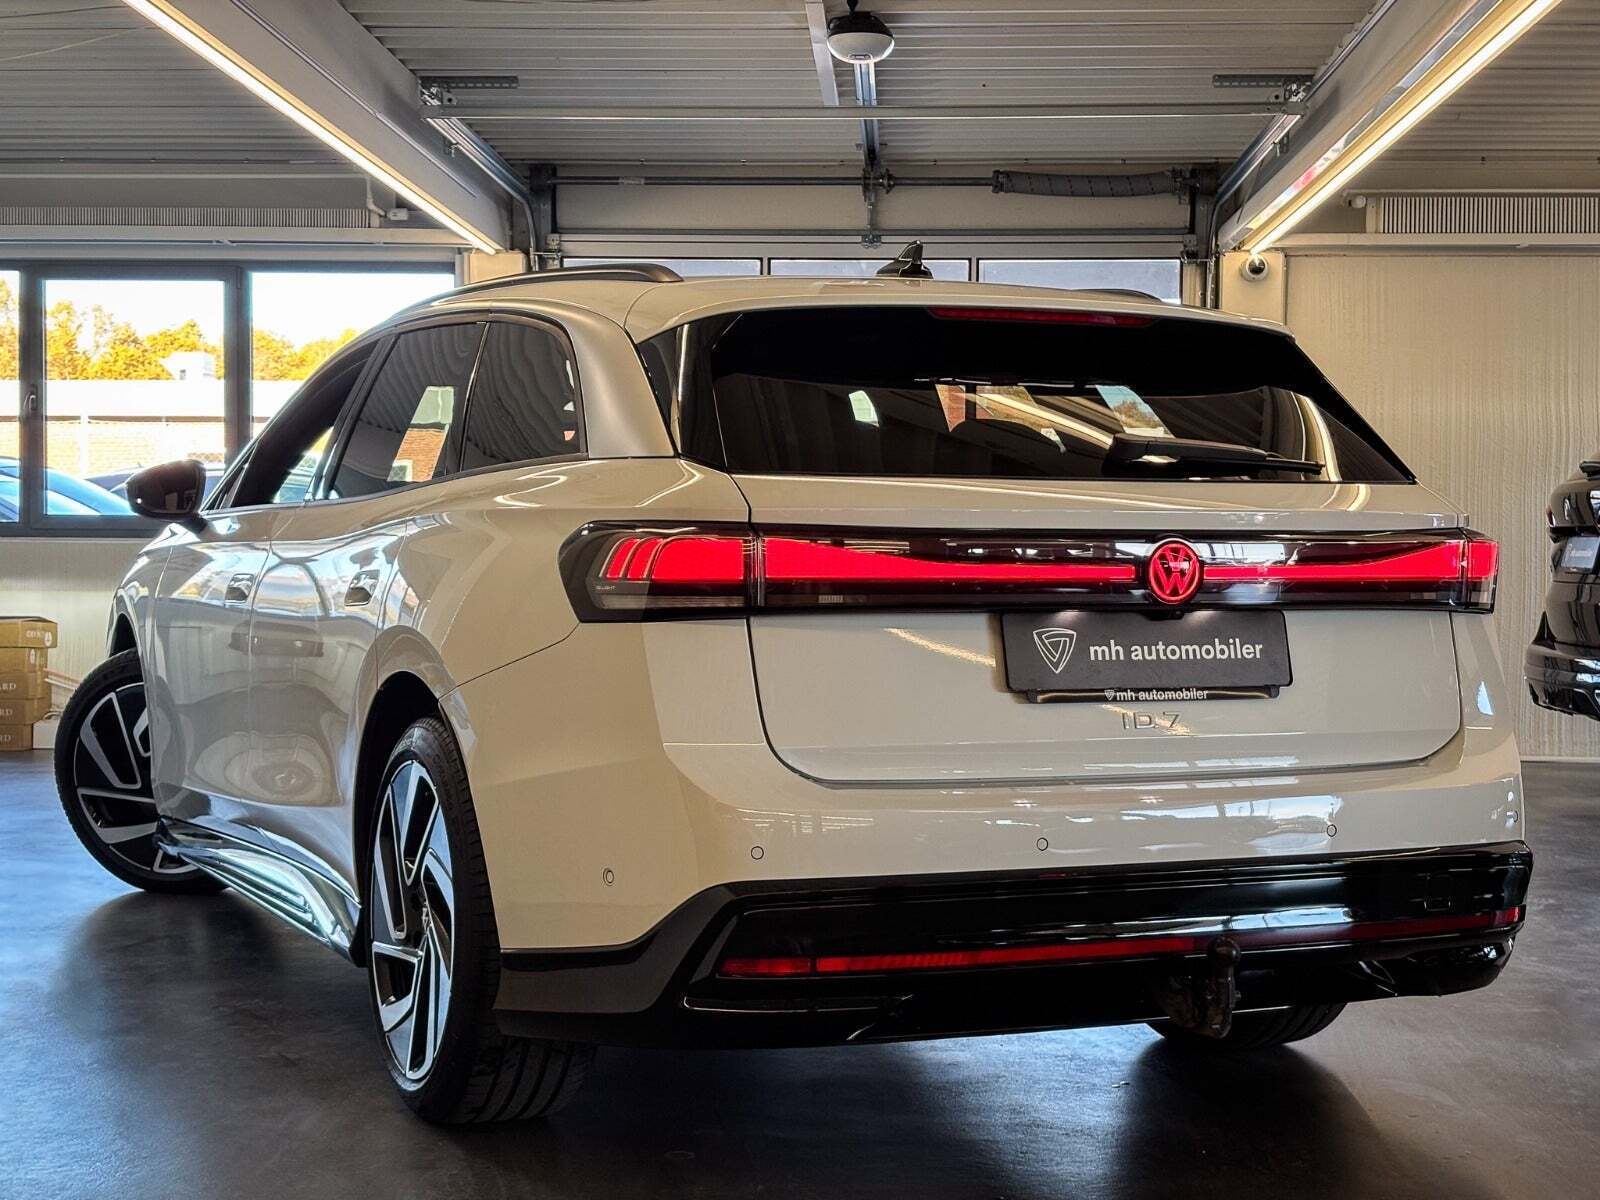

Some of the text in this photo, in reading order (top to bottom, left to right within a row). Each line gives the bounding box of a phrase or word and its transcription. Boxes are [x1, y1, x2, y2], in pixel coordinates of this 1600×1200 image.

[1089, 638, 1263, 661] mh automobiler
[1116, 688, 1209, 701] mh automobiler
[1122, 711, 1183, 730] ID.7
